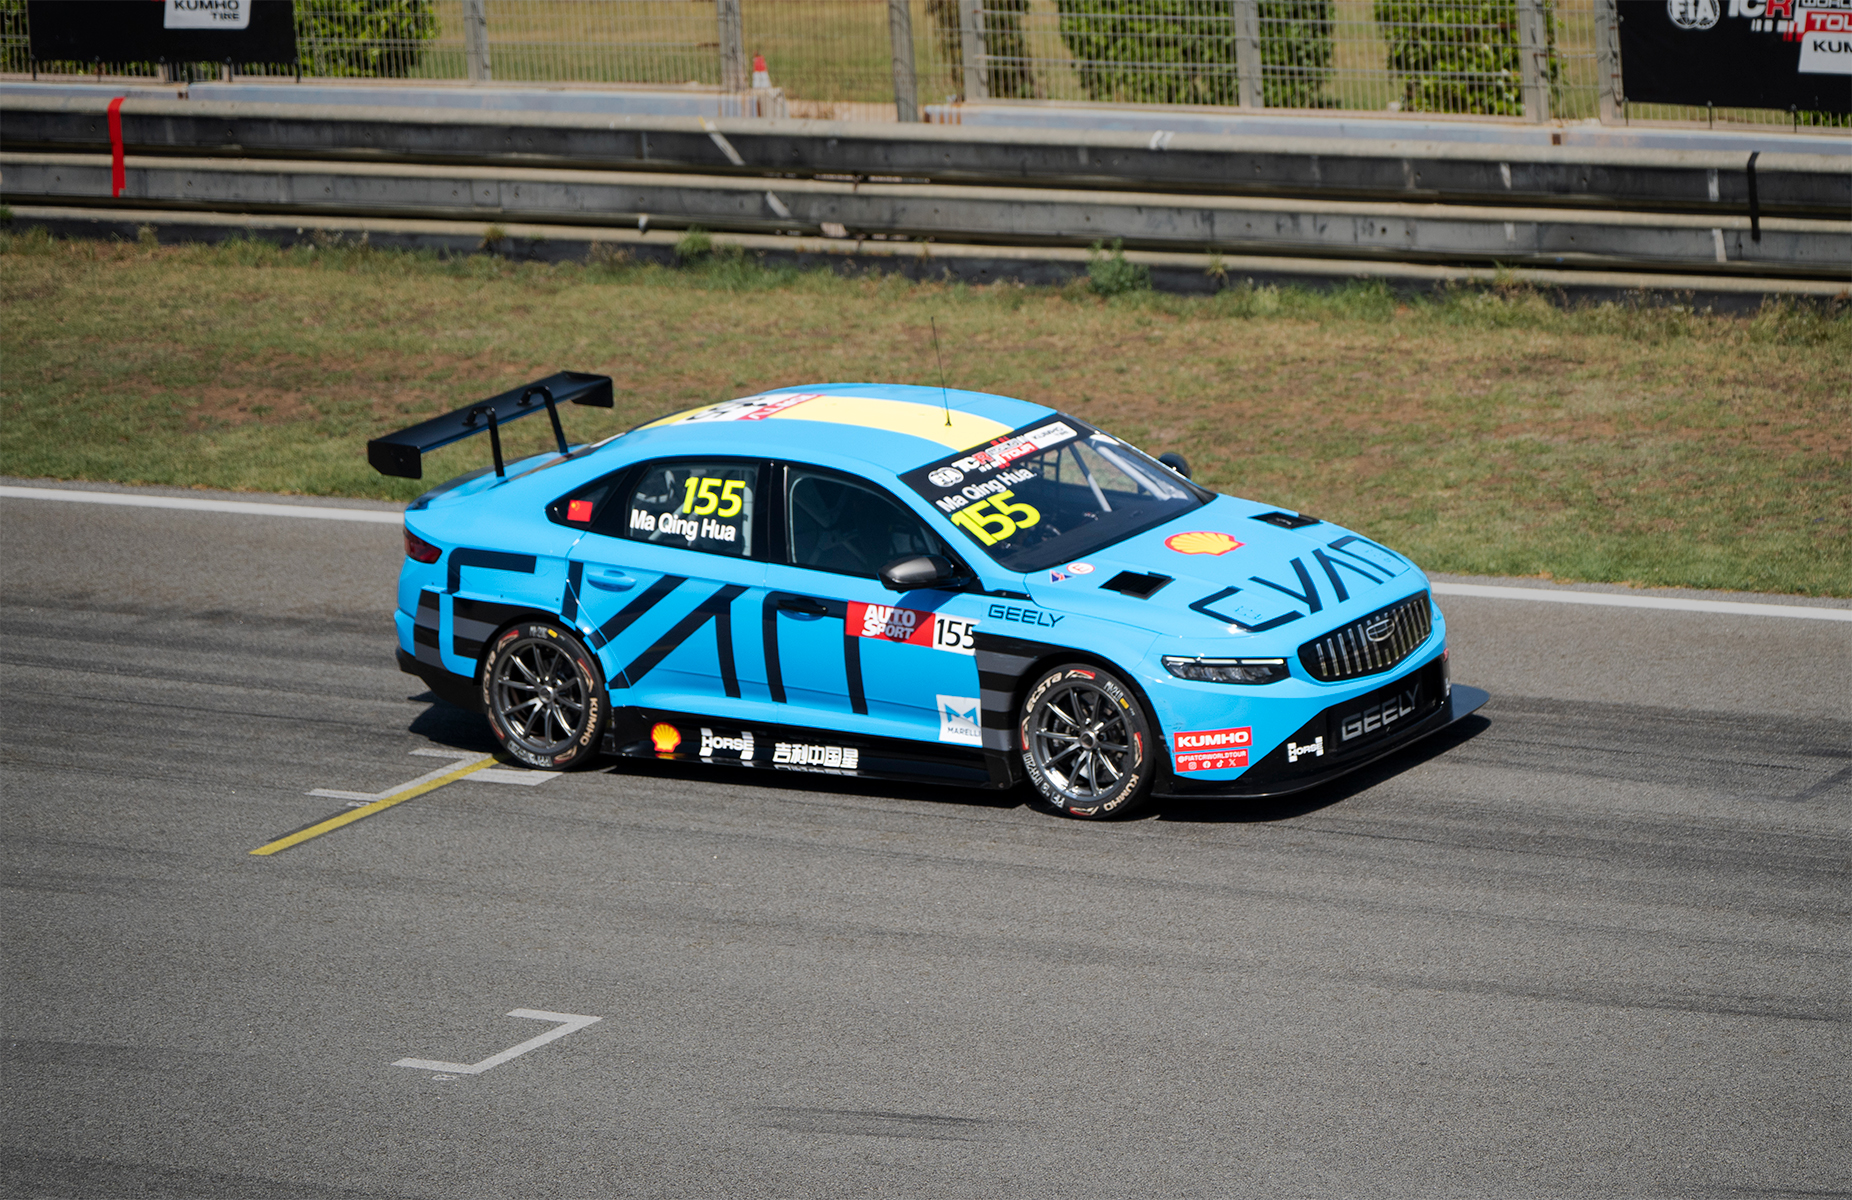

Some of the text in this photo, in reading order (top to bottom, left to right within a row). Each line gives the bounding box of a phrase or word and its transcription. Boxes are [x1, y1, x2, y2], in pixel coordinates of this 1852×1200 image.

[174, 0, 240, 10] KUMHO
[211, 12, 240, 20] TIRE
[1671, 0, 1715, 20] FIA
[951, 451, 994, 473] TCR
[1001, 443, 1035, 460] TOUR
[933, 469, 962, 486] FIA
[682, 476, 746, 518] 155
[935, 468, 1035, 512] Ma Qing Hua
[630, 508, 736, 542] Ma Qing Hua
[950, 490, 1041, 547] 155
[863, 604, 916, 627] AUTO
[988, 603, 1065, 628] GEELY
[861, 619, 915, 640] SPORT
[937, 618, 977, 650] 155
[580, 697, 599, 747] KUMHO
[1341, 683, 1420, 742] GEELY
[700, 731, 755, 757] HORSE
[947, 726, 981, 738] MARELLI
[1178, 731, 1249, 747] KUMHO
[772, 742, 859, 769] 吉利中国星
[1287, 738, 1324, 761] HORSE
[1103, 773, 1140, 811] KUMHO
